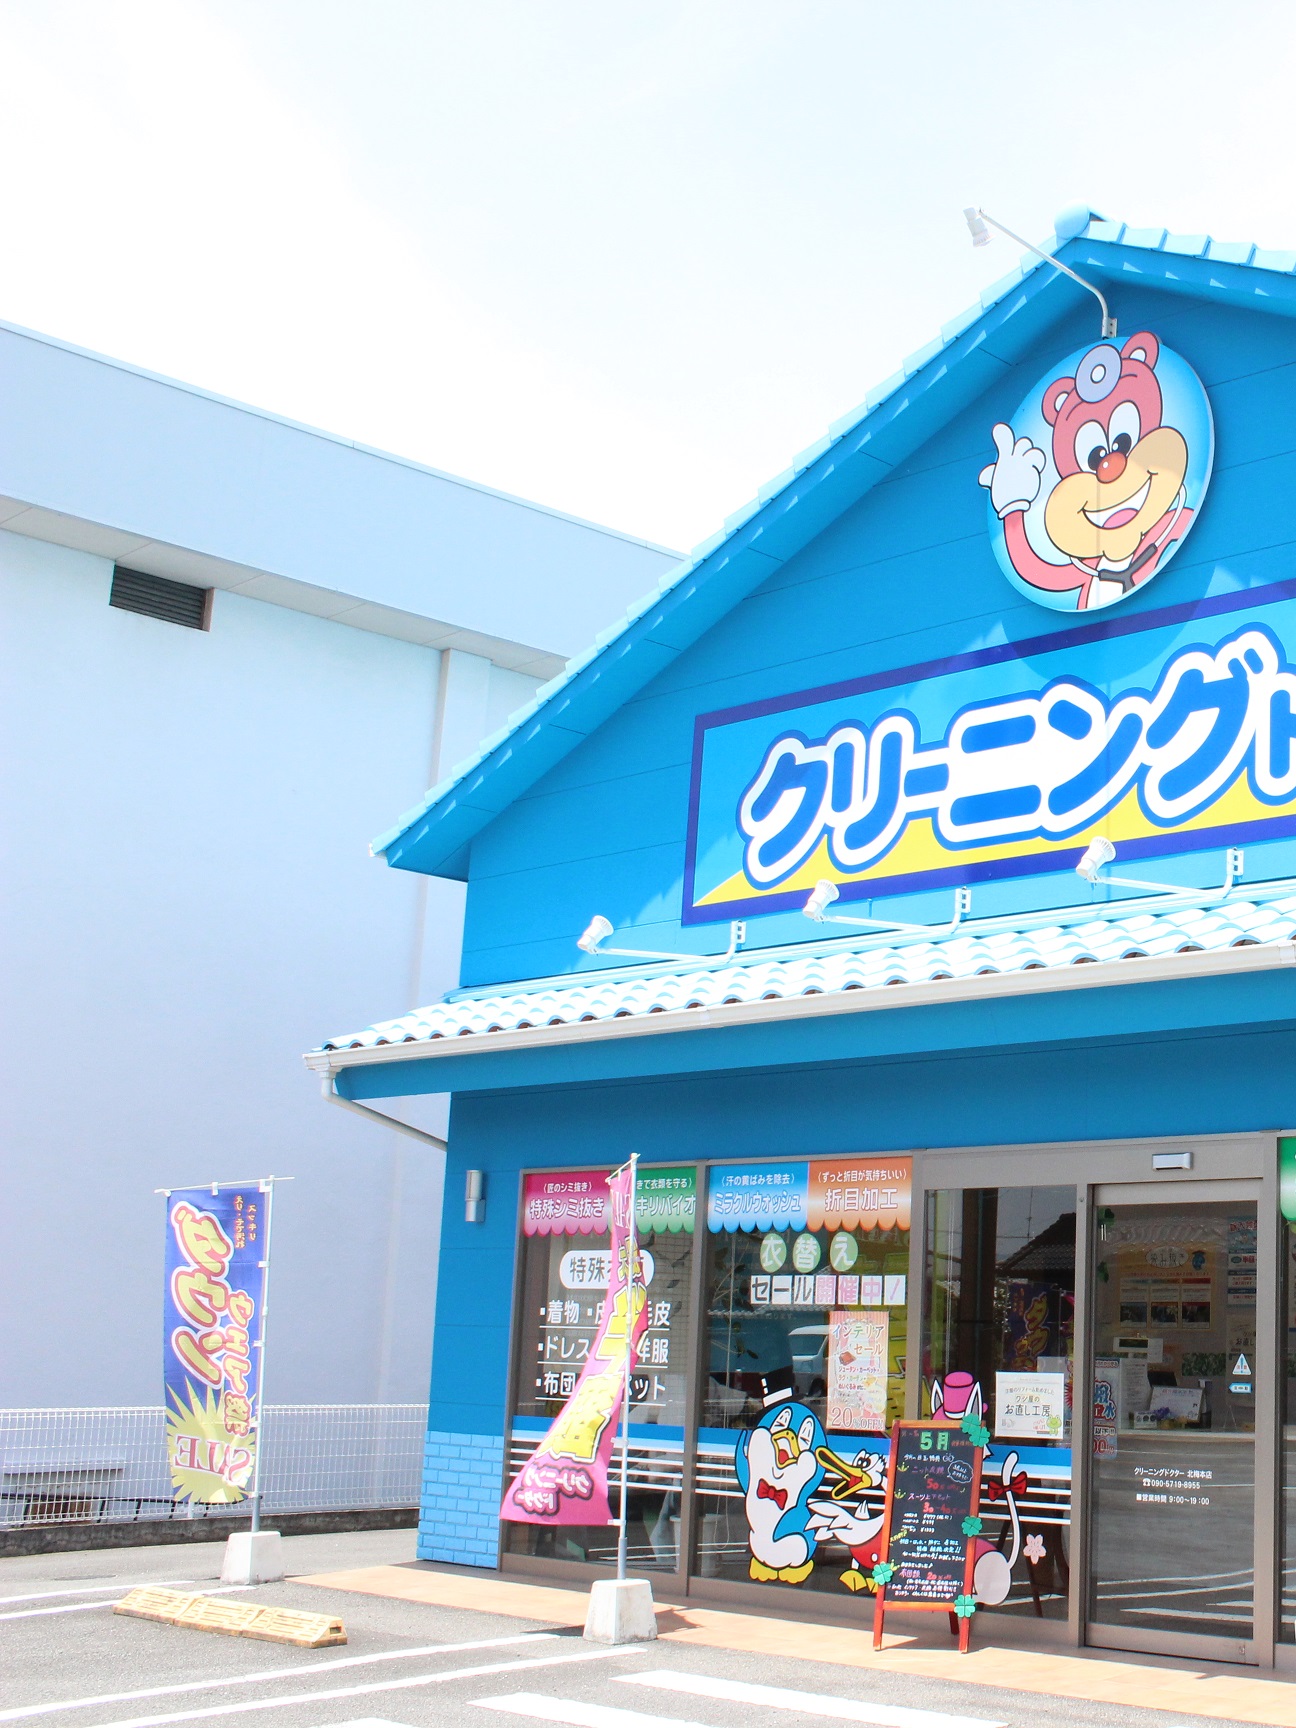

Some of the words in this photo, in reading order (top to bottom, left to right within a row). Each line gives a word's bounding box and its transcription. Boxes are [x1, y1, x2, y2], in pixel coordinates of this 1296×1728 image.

[529, 1197, 605, 1221] 特殊シミ抜き
[636, 1194, 696, 1217] キリバイオ
[714, 1190, 801, 1214] ミラクルウォッシュ
[825, 1187, 898, 1212] 折目加工
[762, 1236, 854, 1269] 衣替え
[833, 1325, 884, 1339] インテリア
[854, 1343, 884, 1356] セール
[1005, 1404, 1051, 1417] お直し工房
[920, 1431, 949, 1451] 5月
[1134, 1466, 1185, 1478] クリーニングドクター
